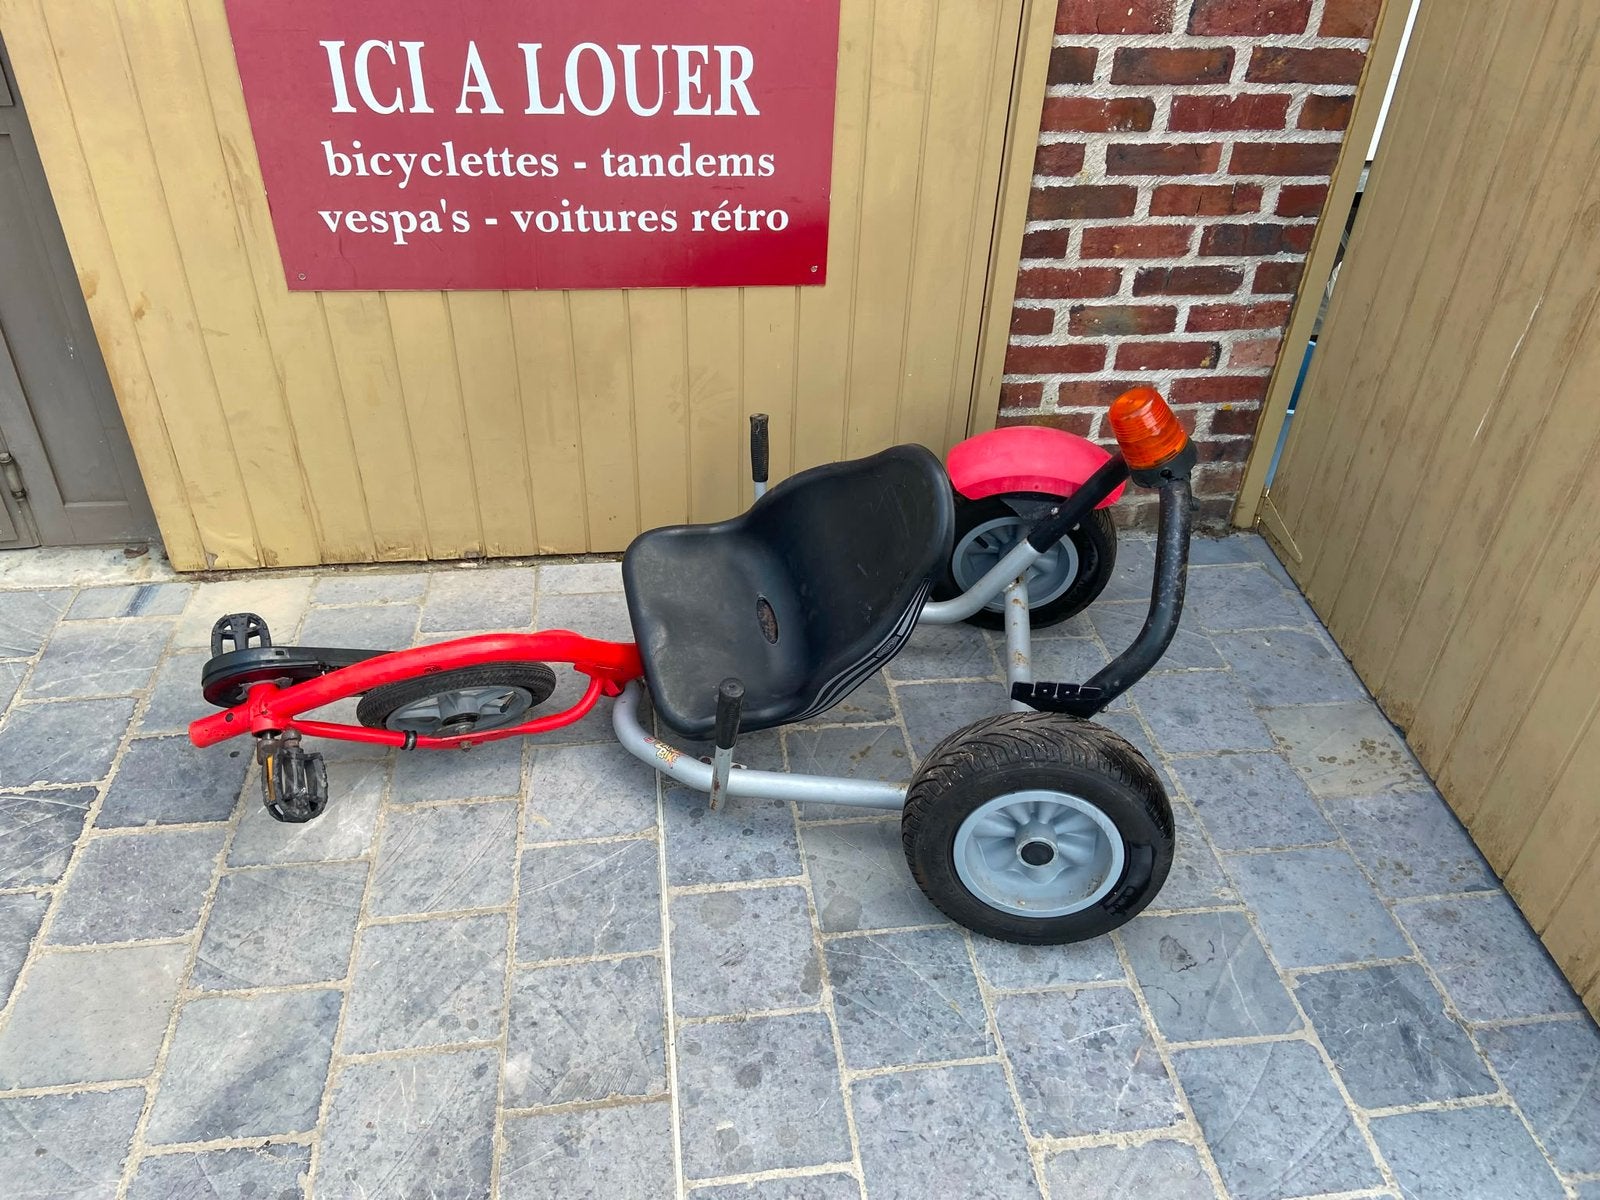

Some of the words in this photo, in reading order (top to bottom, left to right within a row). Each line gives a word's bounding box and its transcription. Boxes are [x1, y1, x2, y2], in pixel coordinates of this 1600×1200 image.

[319, 39, 434, 115] ICI
[456, 40, 505, 115] A
[518, 42, 761, 117] LOUER
[321, 139, 560, 190] bicyclettes
[601, 142, 776, 178] tandems
[318, 198, 471, 246] vespa's
[511, 198, 678, 233] voitures
[692, 199, 789, 232] rétro
